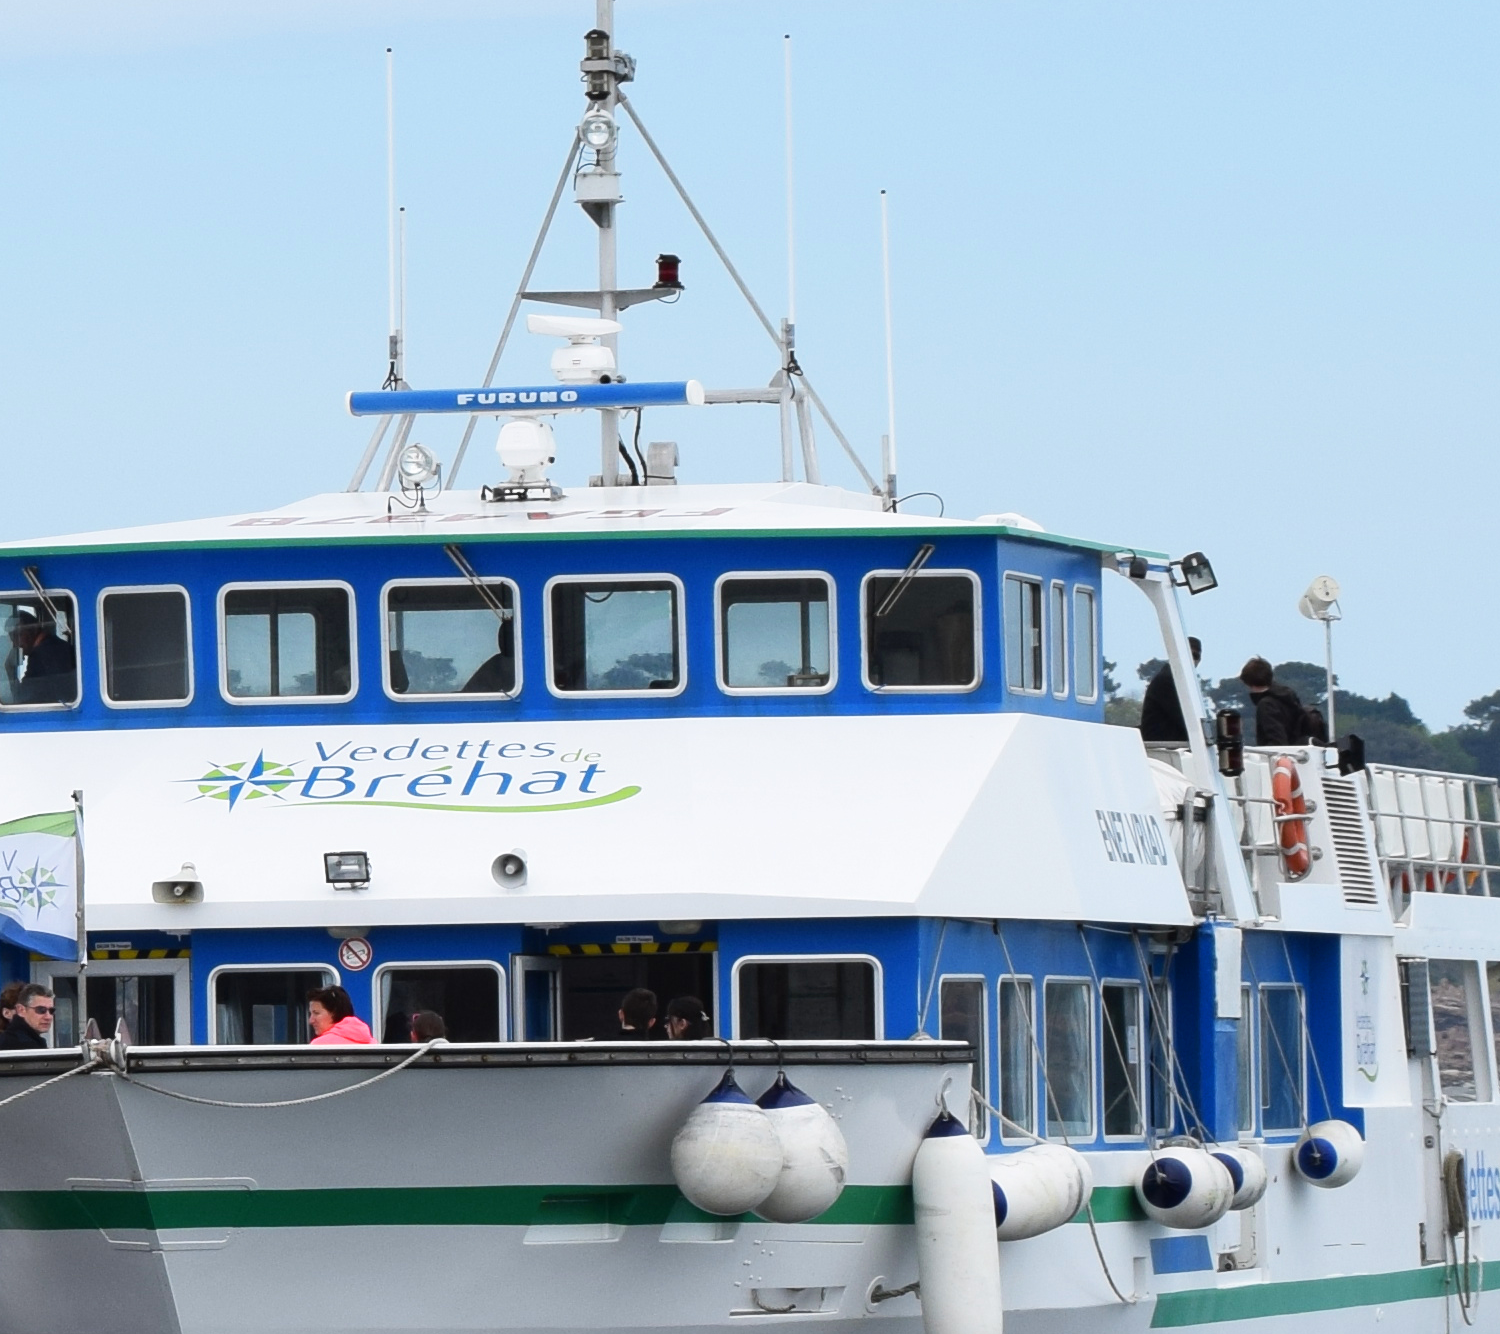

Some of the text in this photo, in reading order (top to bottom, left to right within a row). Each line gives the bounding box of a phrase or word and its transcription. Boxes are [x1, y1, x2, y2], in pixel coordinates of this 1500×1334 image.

[457, 390, 578, 405] FURUNO
[315, 738, 602, 763] Vedettes de
[300, 760, 606, 799] Bréhat
